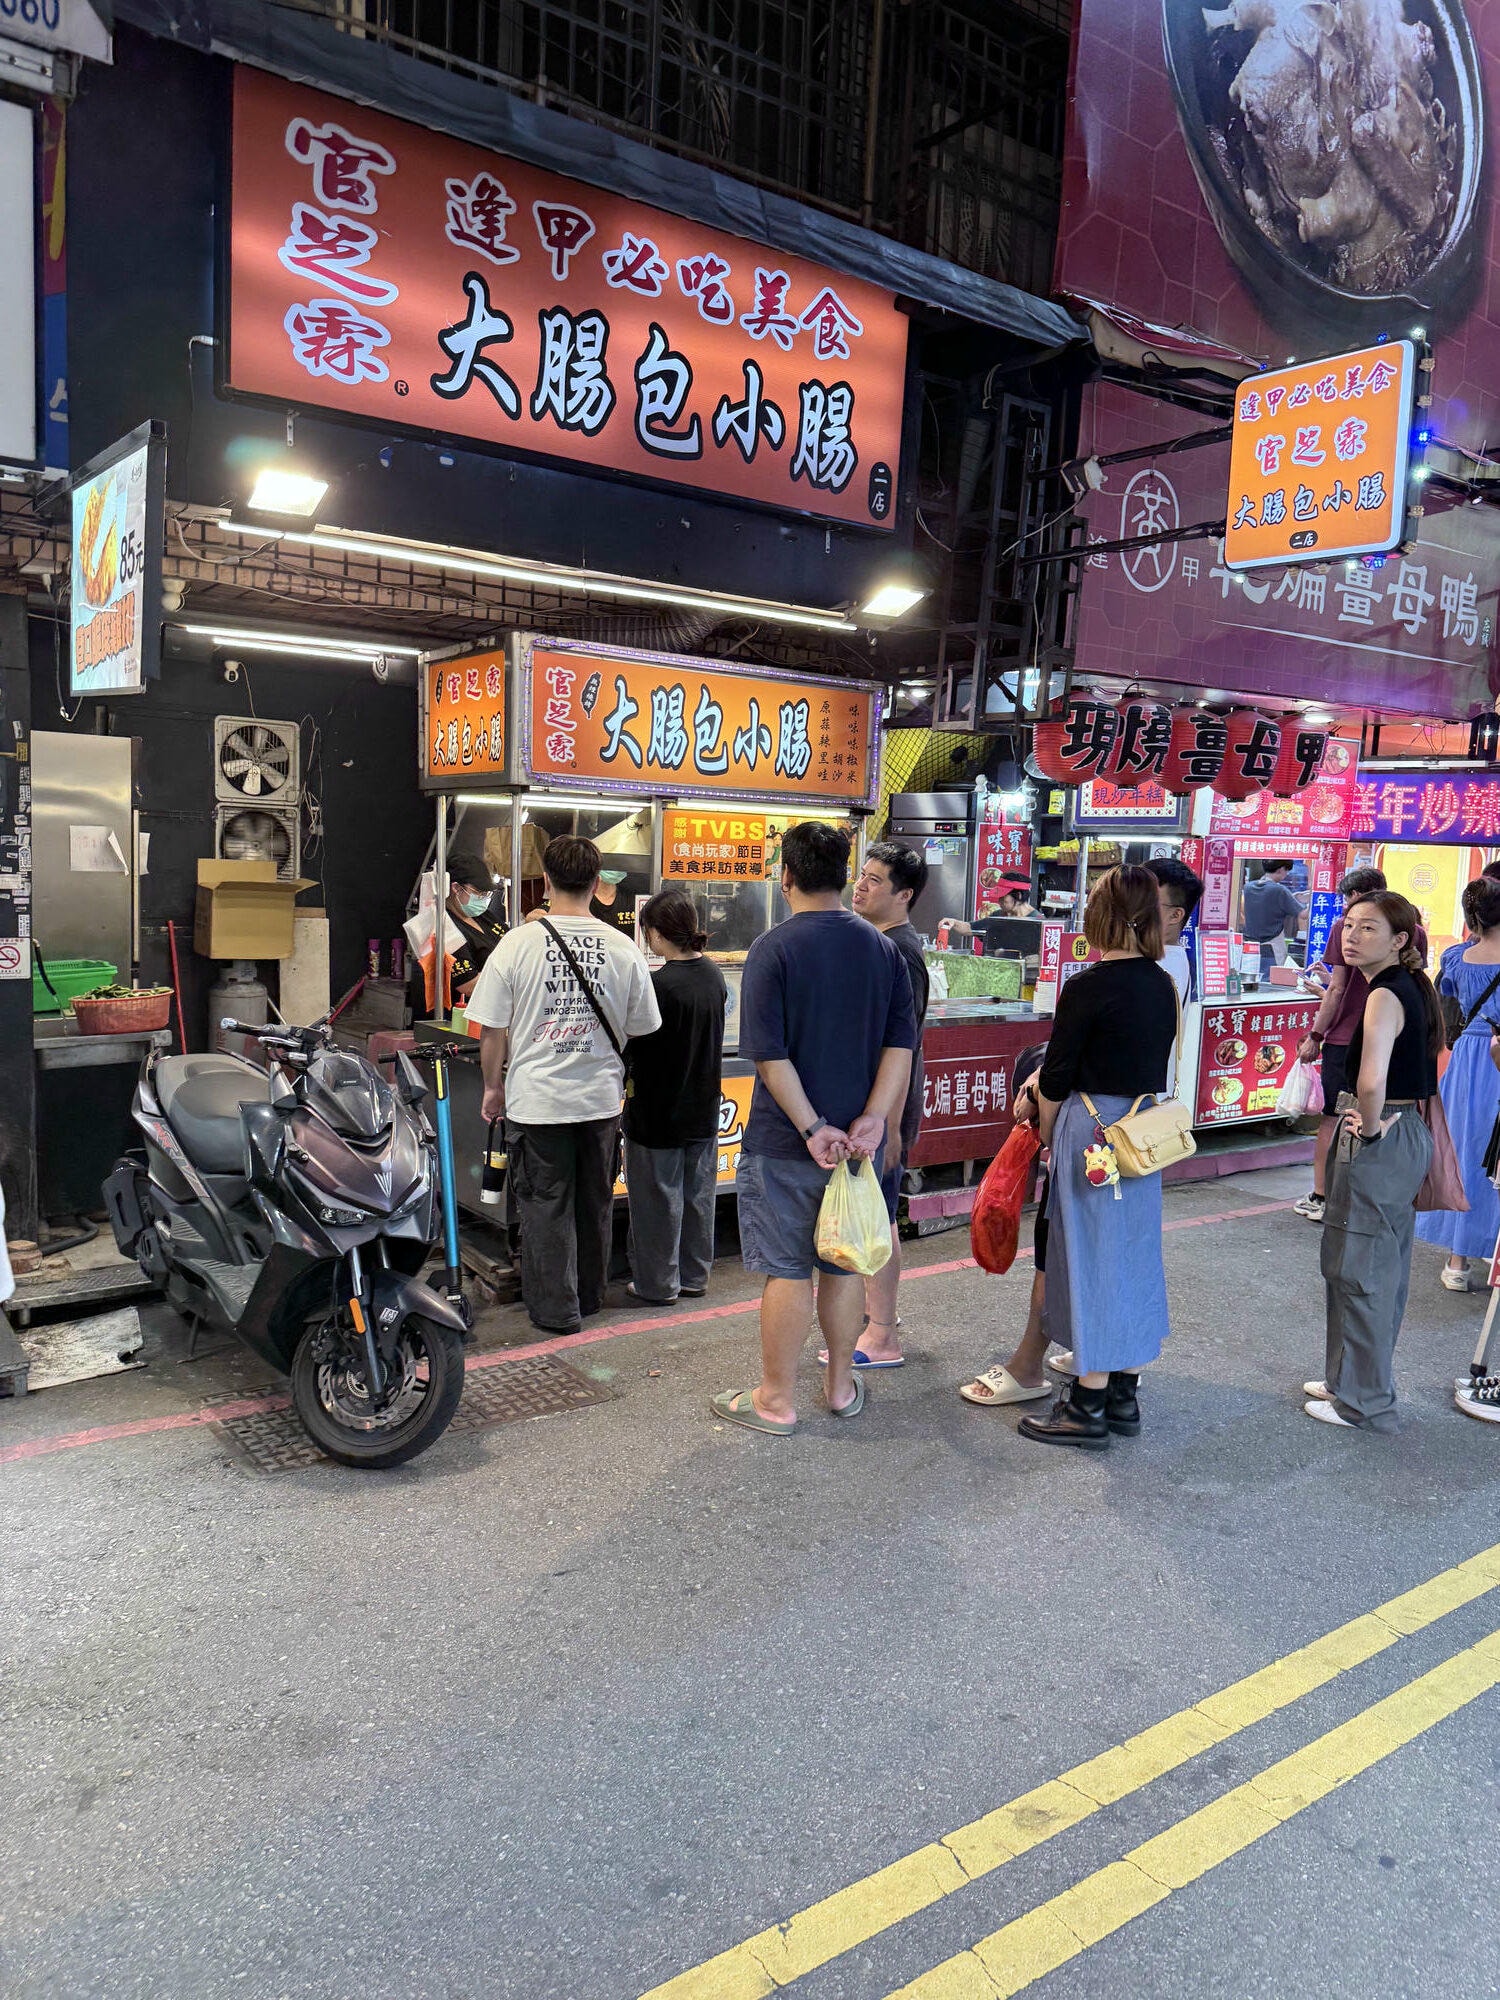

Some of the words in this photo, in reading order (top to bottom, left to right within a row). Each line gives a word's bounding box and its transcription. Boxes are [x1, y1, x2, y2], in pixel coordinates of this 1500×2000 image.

[445, 171, 864, 360] 逢甲必吃美食
[431, 271, 861, 492] 大腸包小腸
[1239, 360, 1398, 422] 逢甲必吃美食
[871, 467, 888, 515] 二店
[1232, 471, 1387, 530] 大腸包小腸
[1291, 533, 1316, 547] 二店
[433, 711, 503, 767] 大腸包小腸
[600, 674, 813, 780] 大腸包小腸
[690, 818, 765, 841] TVBS
[669, 860, 763, 876] 美食採訪報導
[1208, 1009, 1248, 1037] 味寶
[1250, 1010, 1320, 1033] 韓國年糕專
